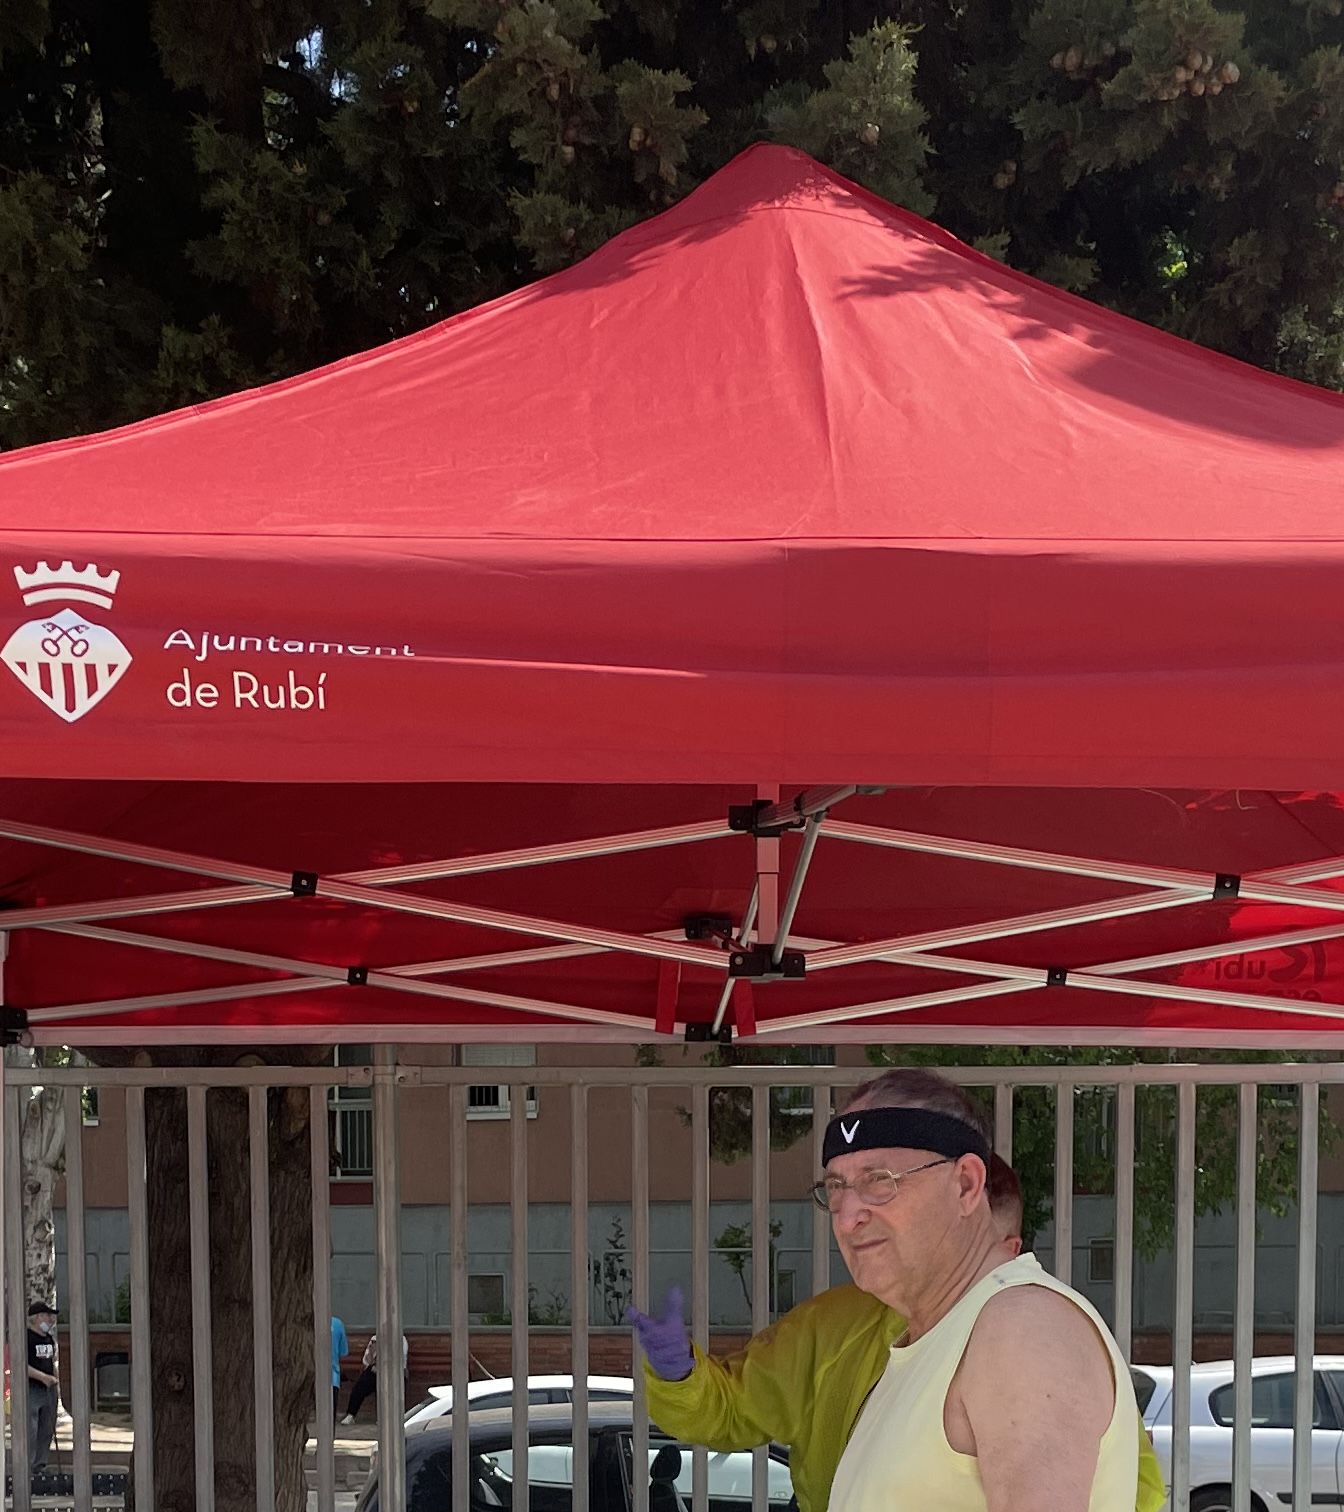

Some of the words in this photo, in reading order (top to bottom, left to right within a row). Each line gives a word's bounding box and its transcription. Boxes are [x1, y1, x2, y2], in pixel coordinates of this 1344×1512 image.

[164, 628, 415, 662] Ajuntament
[166, 667, 220, 708] de
[232, 670, 327, 710] Rubí
